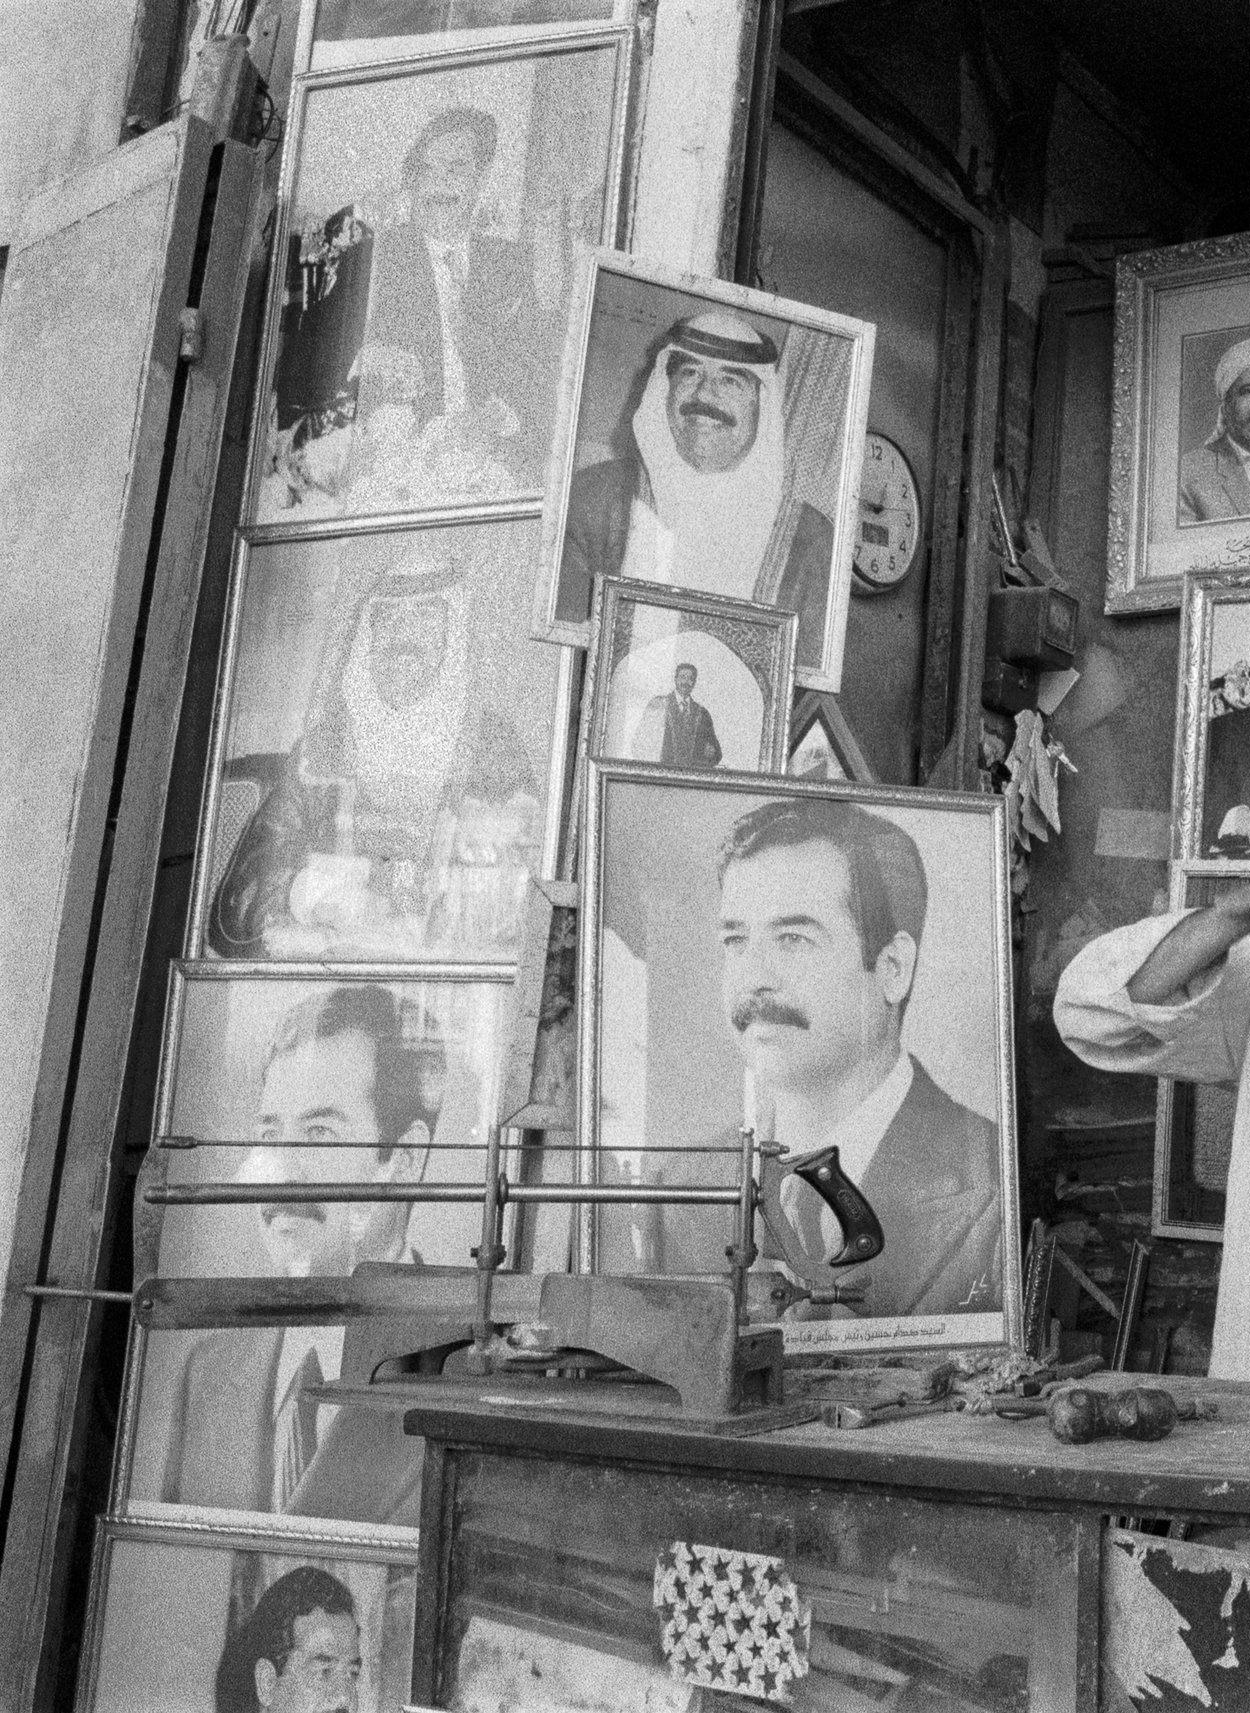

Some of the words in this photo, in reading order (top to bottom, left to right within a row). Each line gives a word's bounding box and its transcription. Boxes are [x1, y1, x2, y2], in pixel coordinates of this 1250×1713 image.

[871, 443, 882, 460] 12
[891, 460, 895, 473] 1
[902, 484, 908, 499] 2
[905, 513, 911, 528] 3
[855, 544, 862, 560] 7
[900, 540, 906, 553] 4
[871, 558, 879, 573] 6
[889, 555, 896, 571] 5
[814, 1327, 839, 1344] مجلس
[842, 1327, 864, 1343] رئيس
[865, 1329, 892, 1342] حسين
[893, 1324, 919, 1339] صدام
[920, 1322, 946, 1337] السيد
